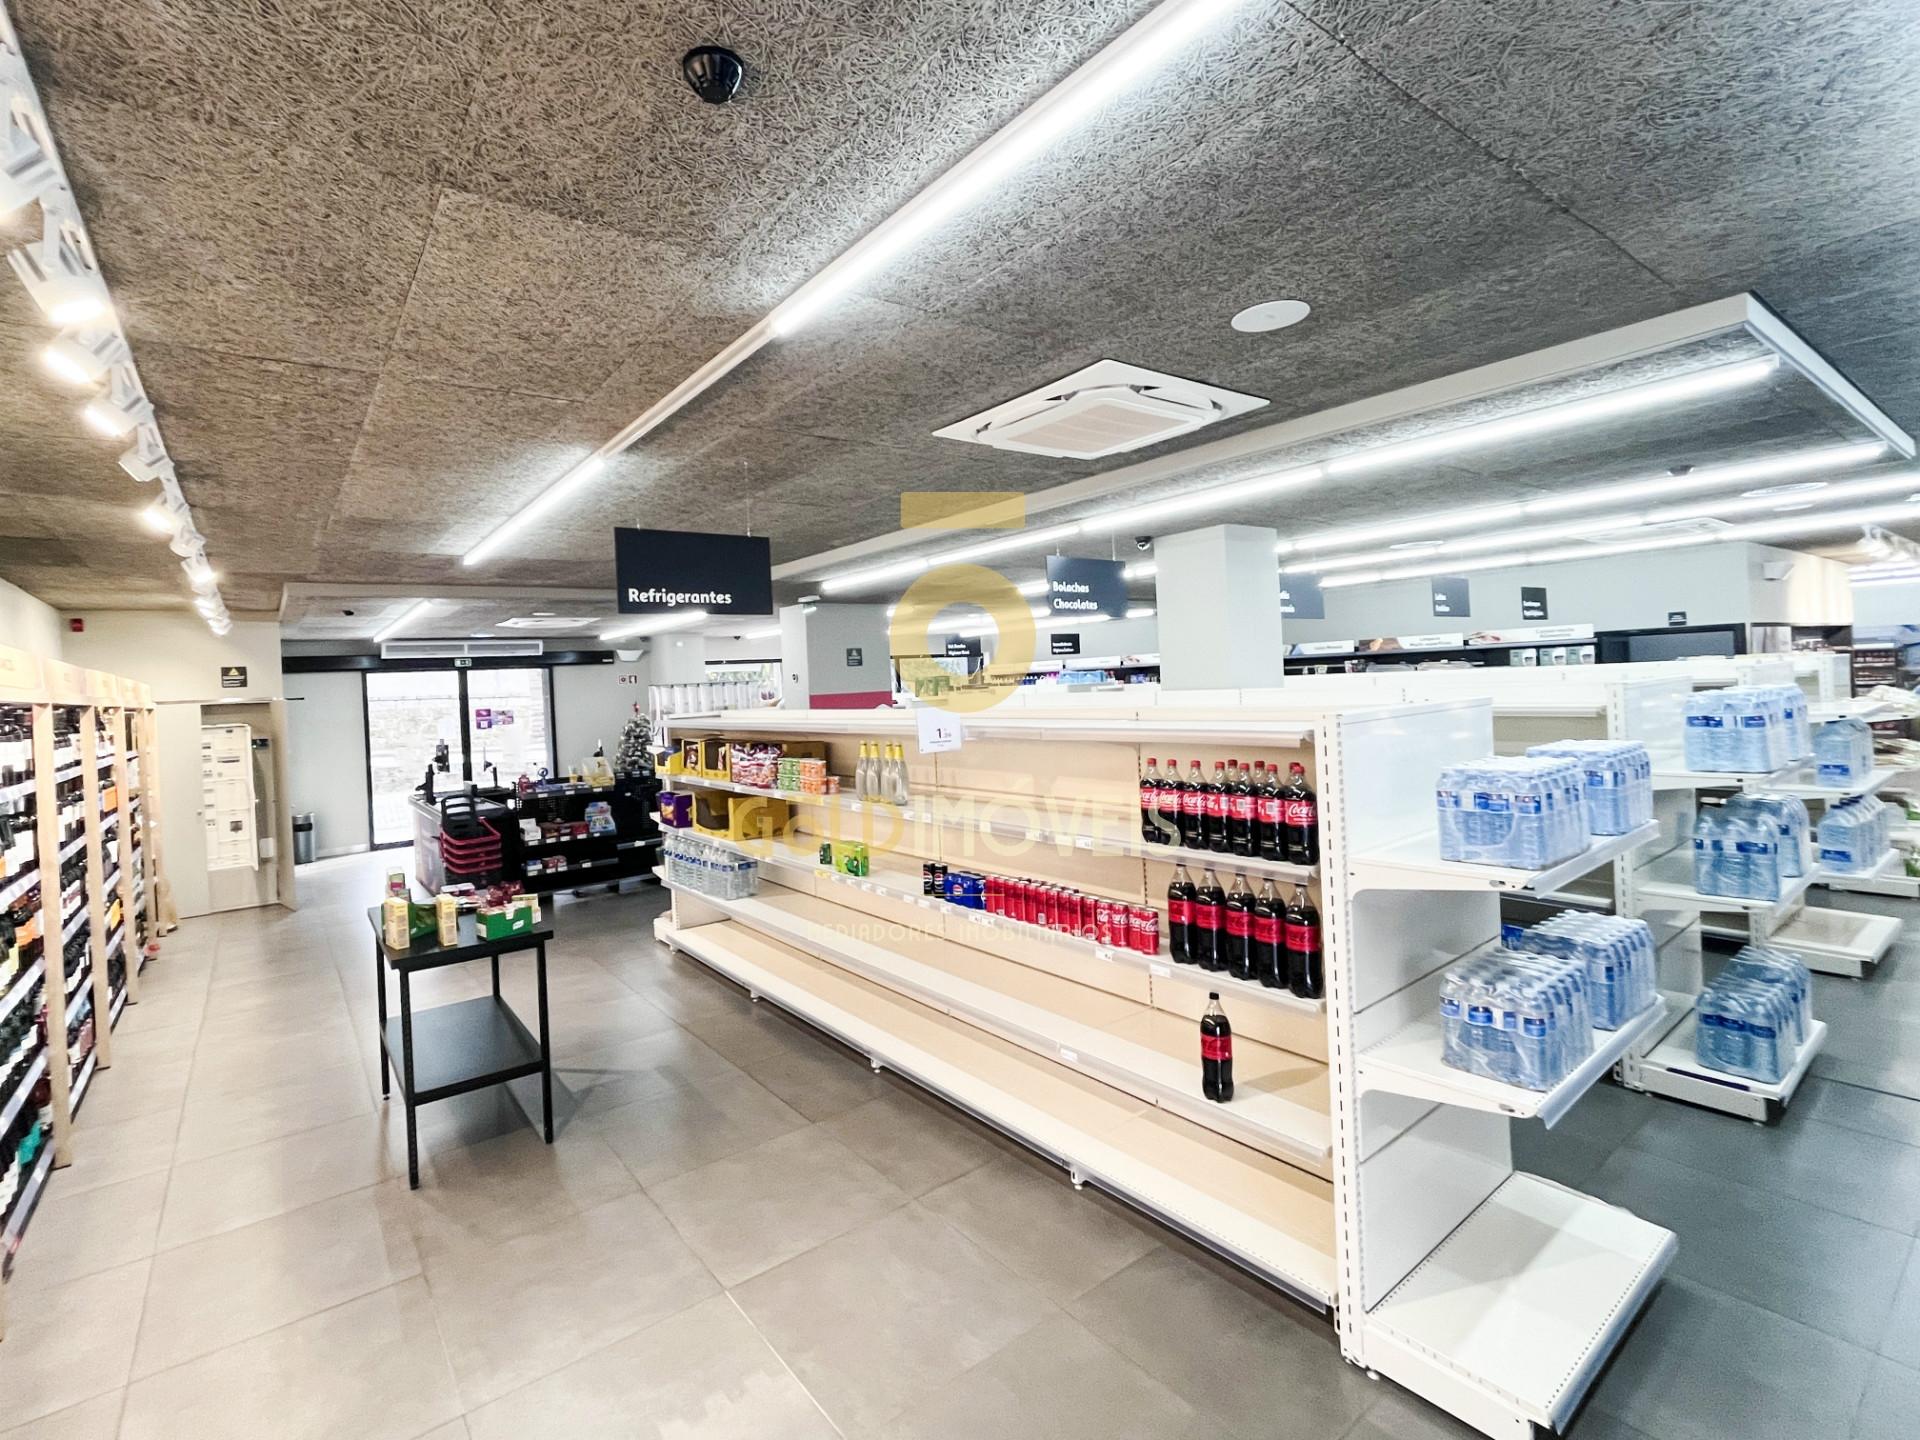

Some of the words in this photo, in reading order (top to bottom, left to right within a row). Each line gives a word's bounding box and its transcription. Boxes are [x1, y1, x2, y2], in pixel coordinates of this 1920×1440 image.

[1052, 580, 1090, 593] Bolachas
[628, 588, 733, 607] Refrigerantes
[1053, 598, 1099, 610] Chocolates
